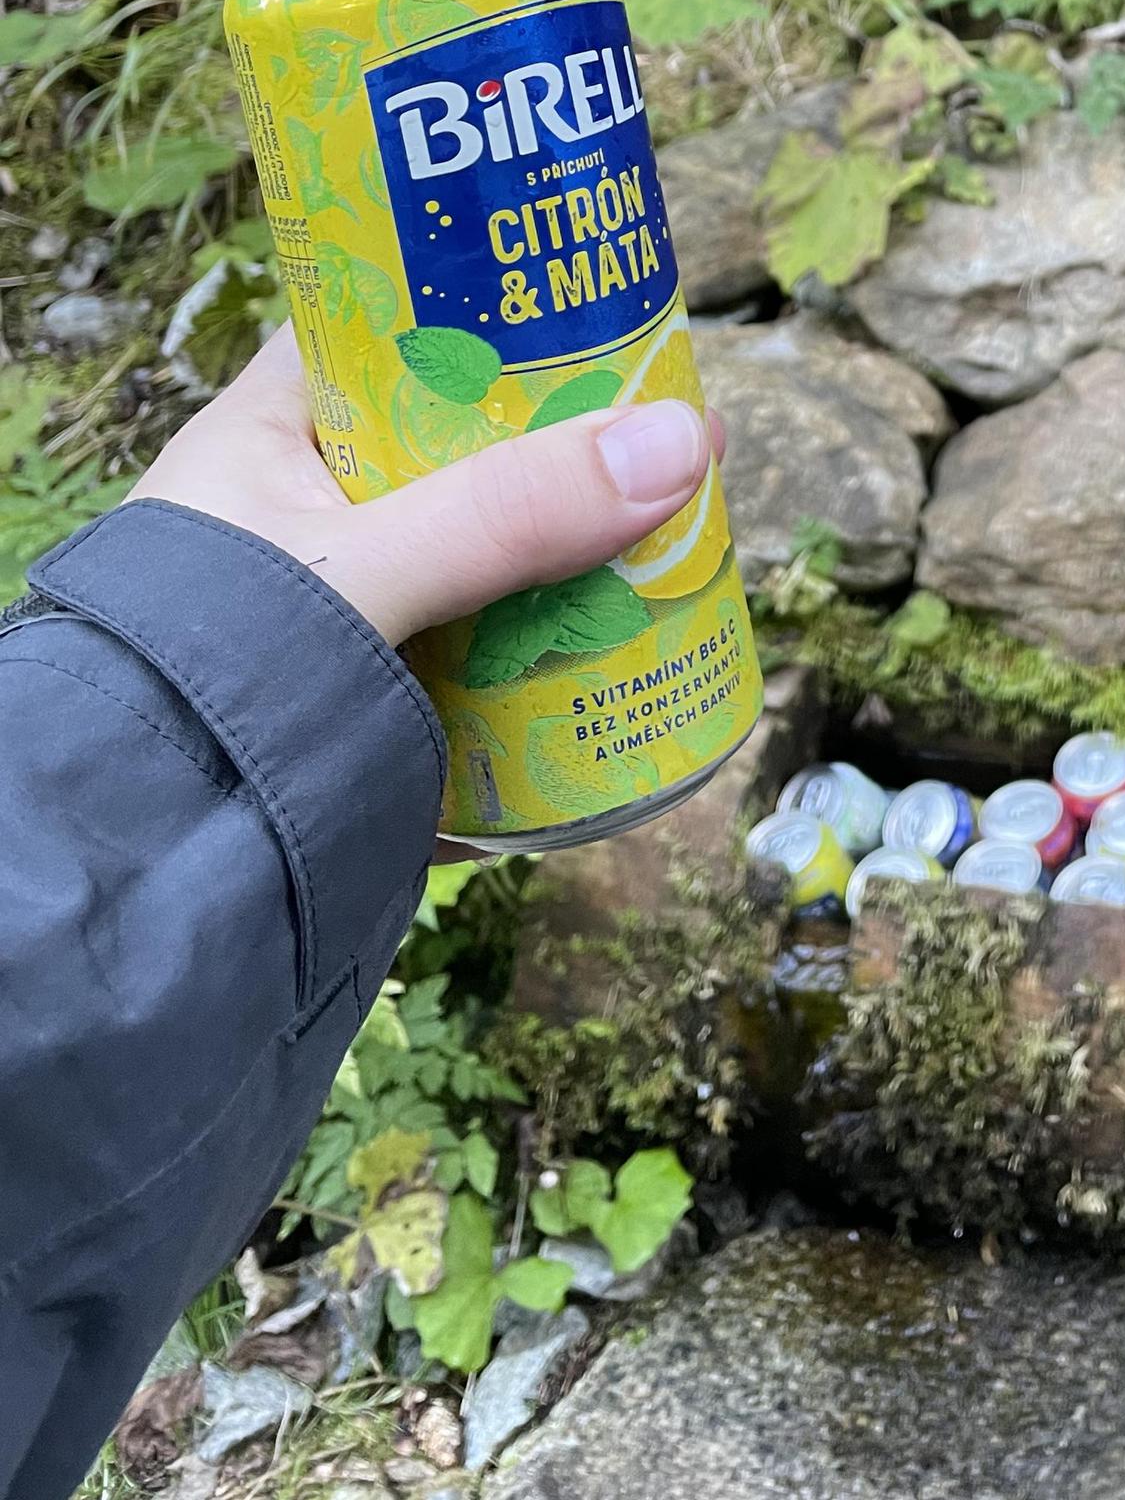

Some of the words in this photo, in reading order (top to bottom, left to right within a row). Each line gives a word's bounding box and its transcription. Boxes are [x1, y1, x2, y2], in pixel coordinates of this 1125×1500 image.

[488, 165, 646, 265] CITRÓN
[526, 172, 537, 186] S
[541, 147, 605, 182] PŘÍCHUTÍ
[500, 270, 544, 325] &
[546, 224, 660, 313] MÁTA
[572, 698, 586, 715] S
[591, 650, 695, 708] VITAMÍNY
[699, 636, 717, 661] B6
[721, 627, 728, 645] &
[729, 618, 735, 635] C
[576, 716, 616, 741] BEZ
[626, 639, 741, 723] KONZERVANTŮ
[595, 746, 608, 762] A
[613, 706, 697, 754] UMĚLÝCH
[700, 671, 741, 714] BARVIV
